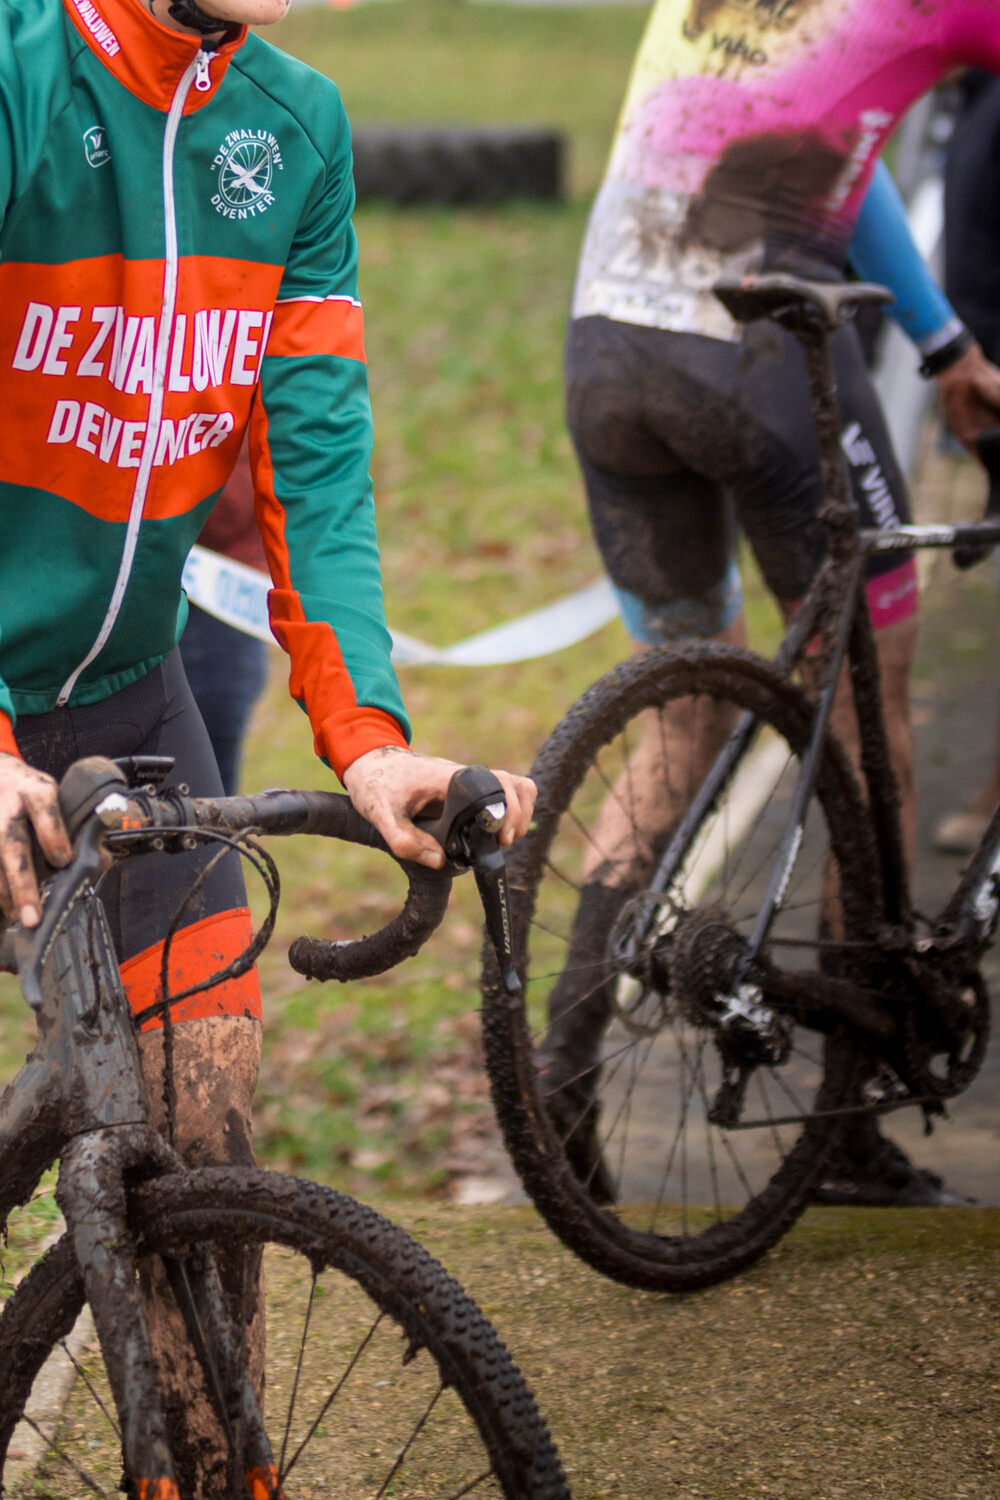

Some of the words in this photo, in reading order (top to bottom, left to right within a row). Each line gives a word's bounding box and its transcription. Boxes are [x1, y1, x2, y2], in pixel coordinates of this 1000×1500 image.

[210, 193, 276, 220] DEVENTER
[12, 302, 82, 376] DE
[498, 879, 511, 955] ULTEGRA
